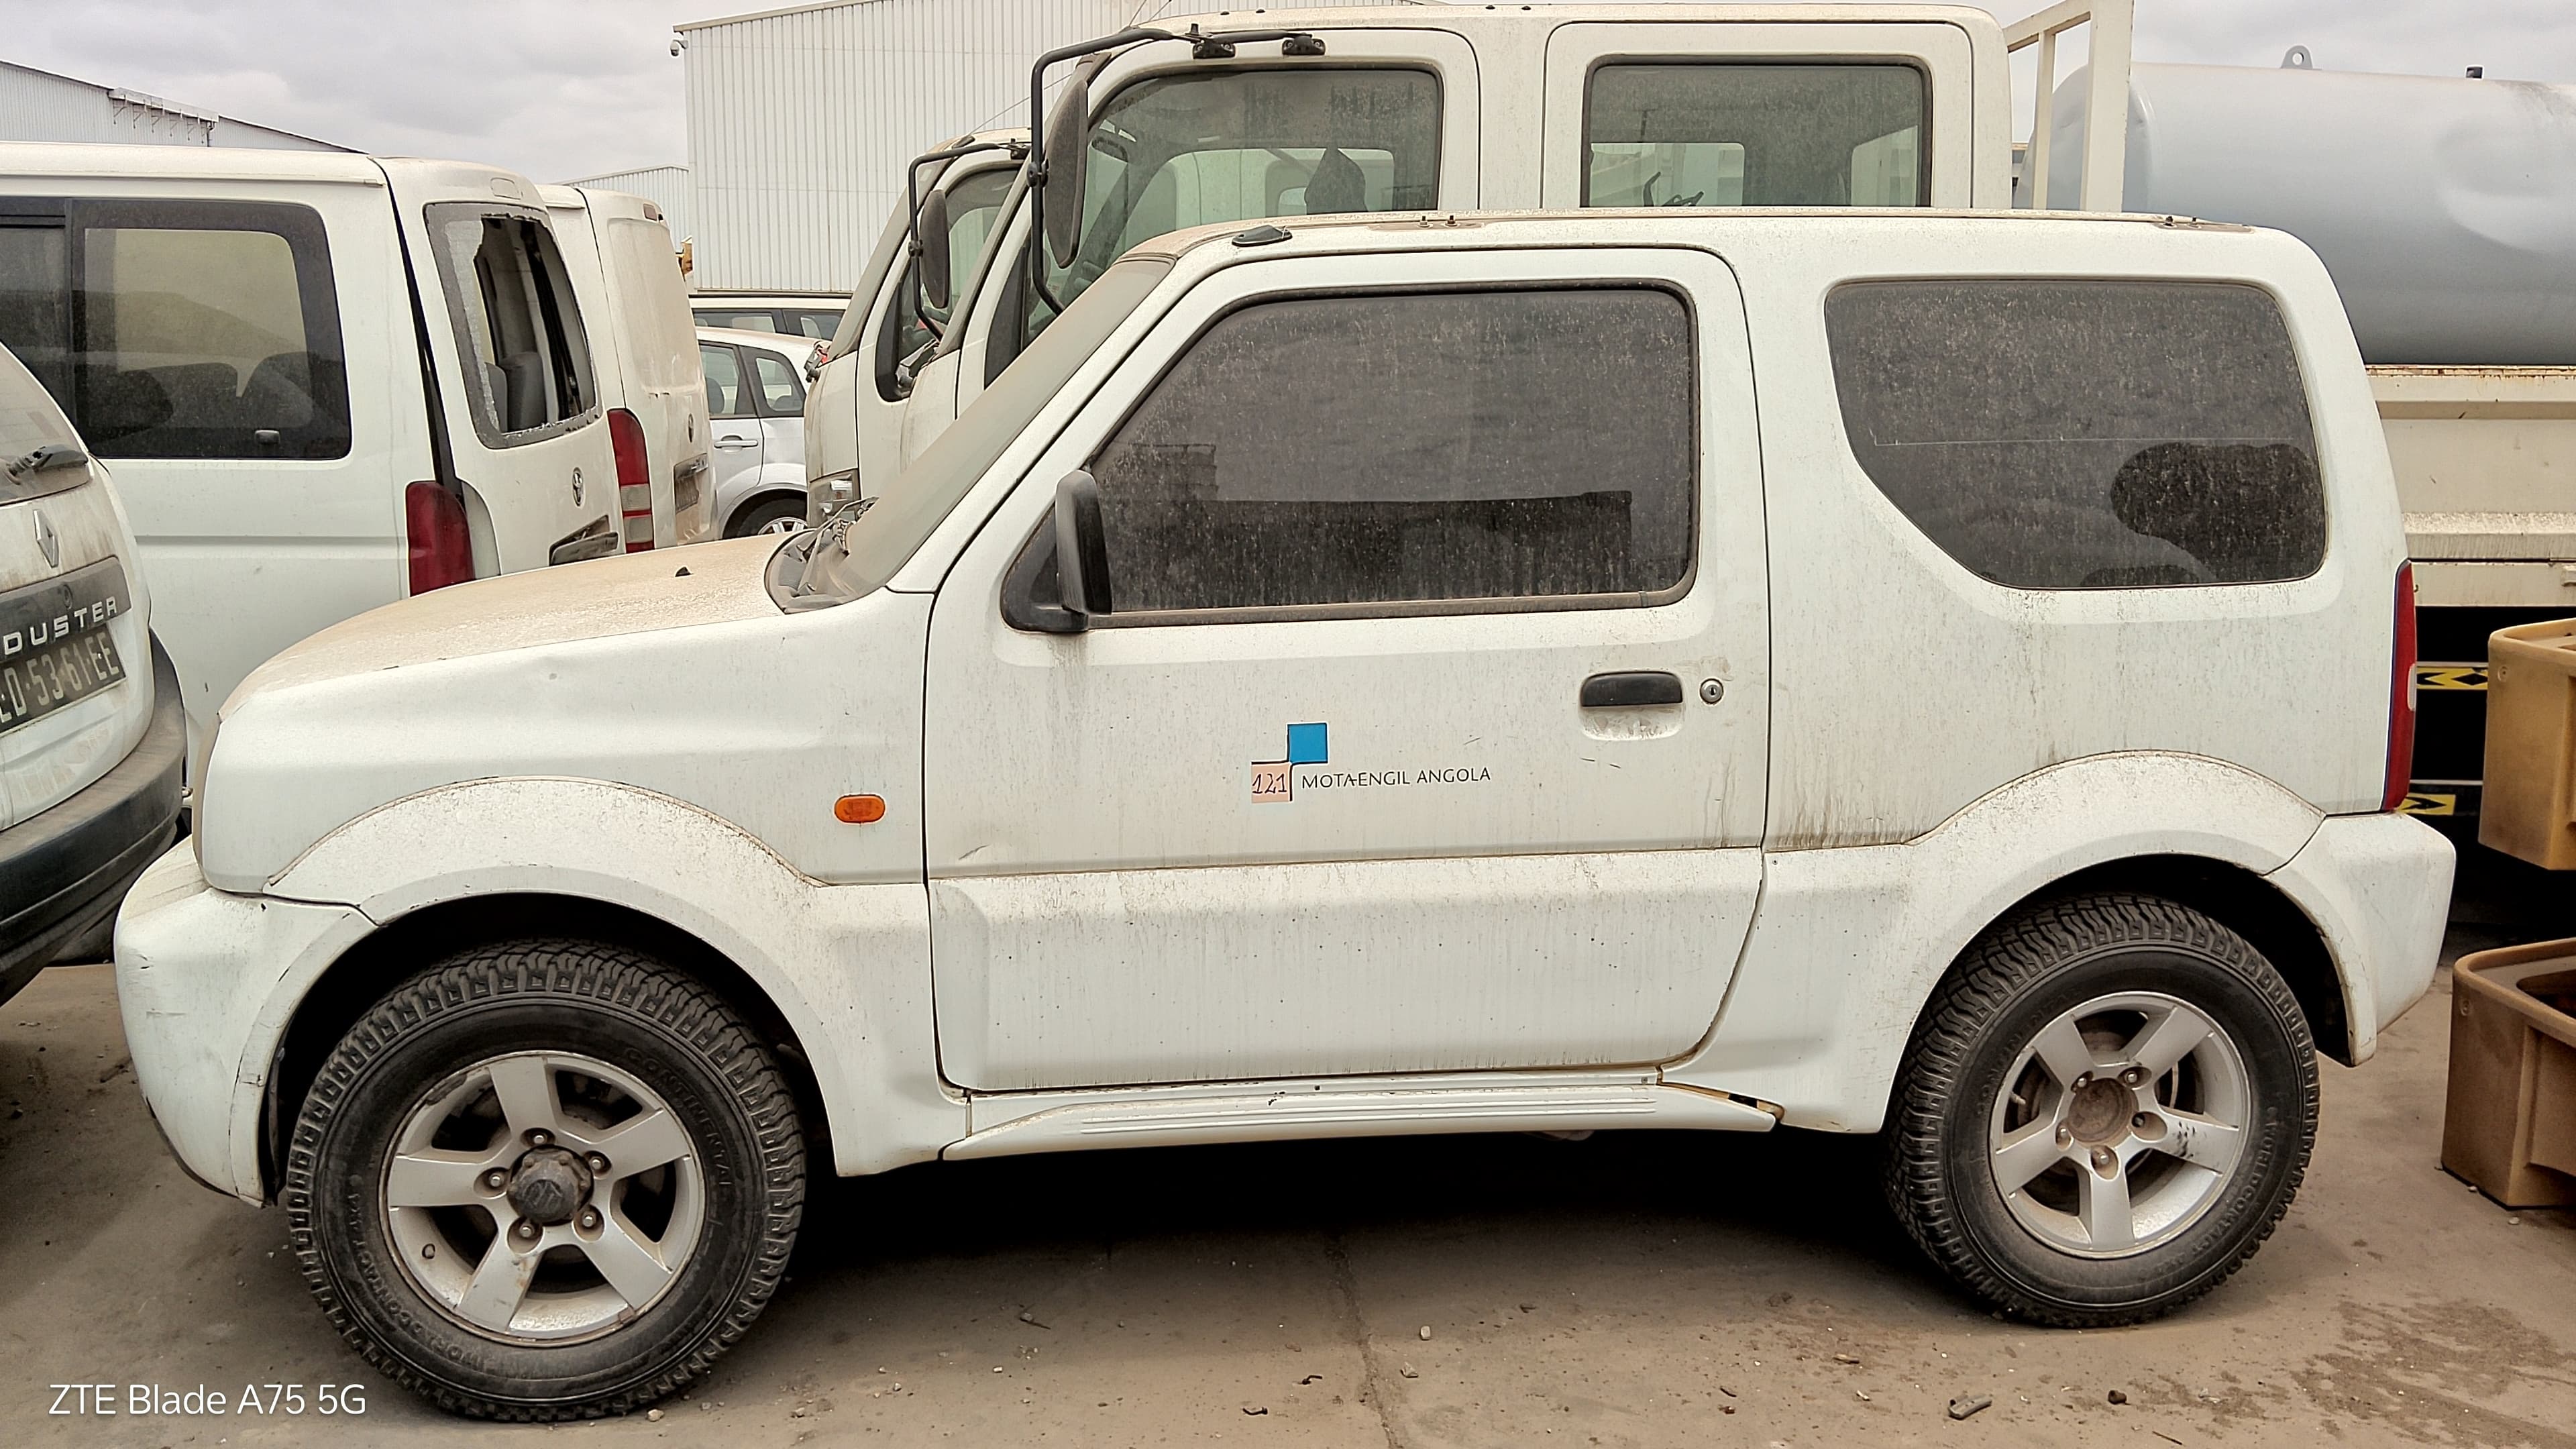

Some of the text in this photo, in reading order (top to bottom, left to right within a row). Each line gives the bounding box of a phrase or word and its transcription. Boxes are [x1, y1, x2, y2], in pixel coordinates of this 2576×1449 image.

[3, 596, 117, 655] DUSTER
[1252, 773, 1288, 794] 121
[1416, 767, 1491, 784] ANGOLA
